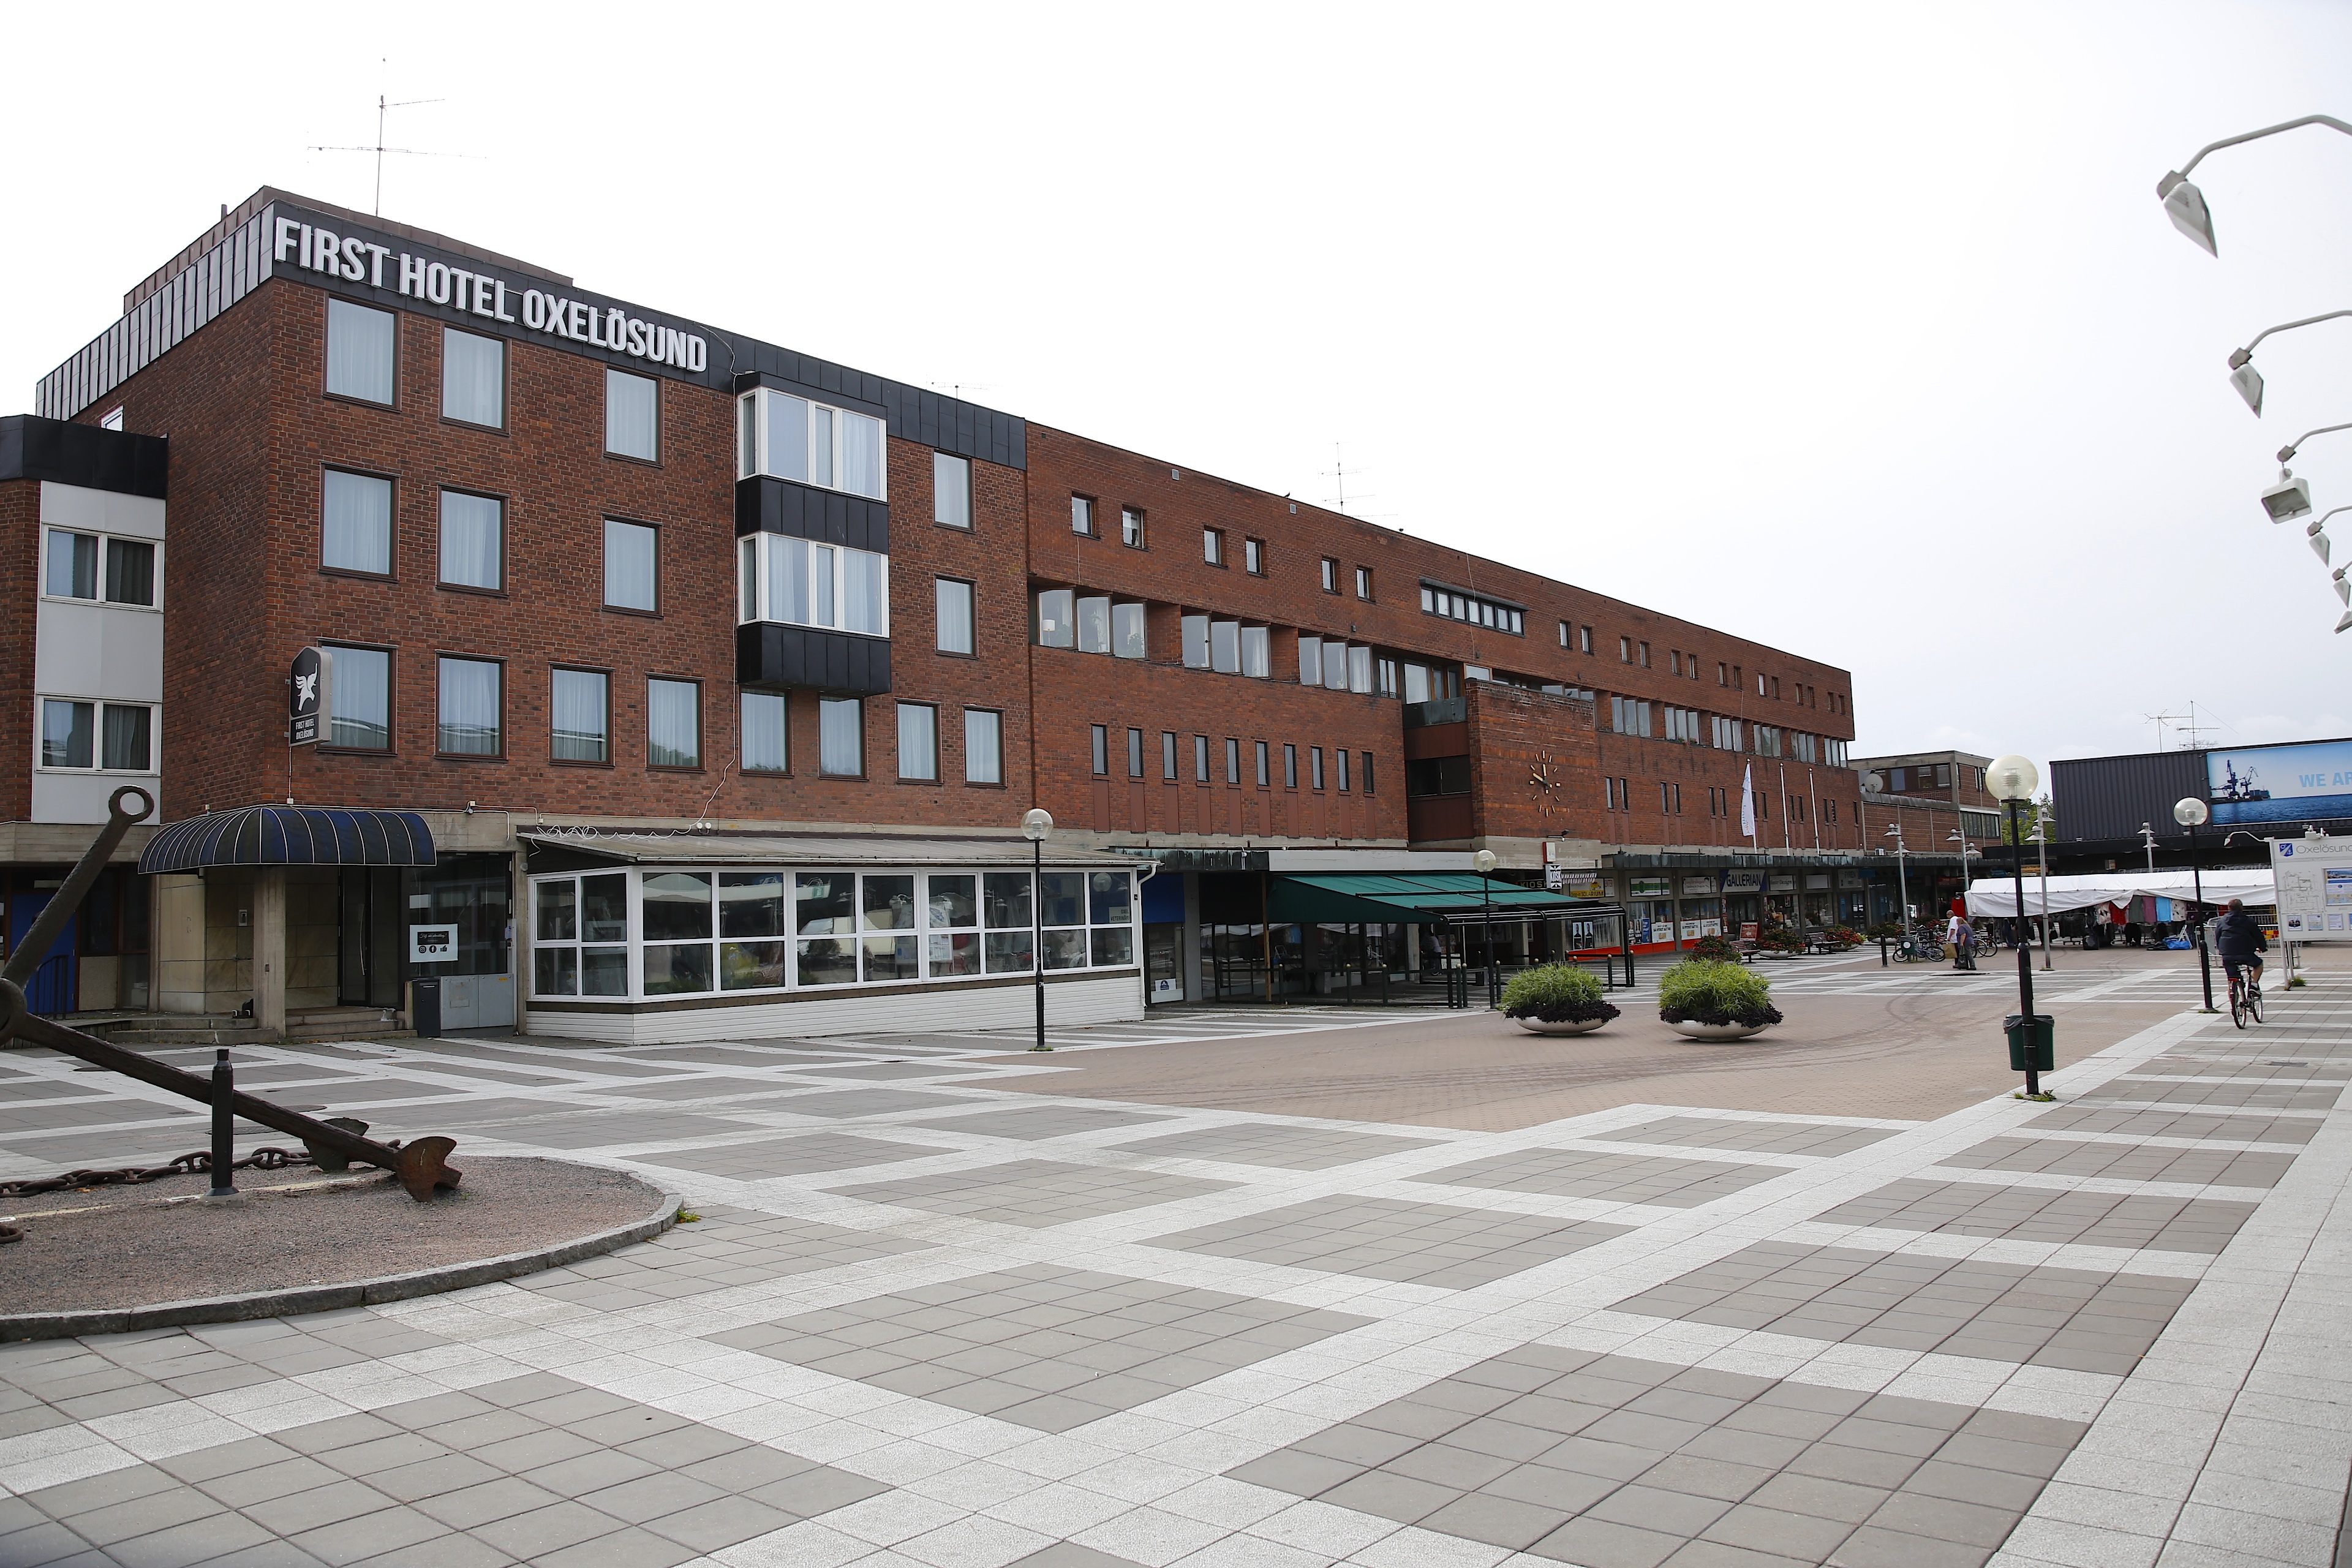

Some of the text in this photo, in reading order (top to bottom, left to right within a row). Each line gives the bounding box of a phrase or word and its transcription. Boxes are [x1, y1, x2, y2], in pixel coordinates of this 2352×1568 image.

[275, 216, 708, 372] FIRST HOTEL OXELÖSUND
[296, 718, 315, 730] FIRST HOTEL
[296, 728, 314, 740] OXELÖSUND
[2299, 774, 2326, 787] WE
[1550, 871, 1562, 882] KIOSK
[1727, 874, 1762, 887] GALLERIAN
